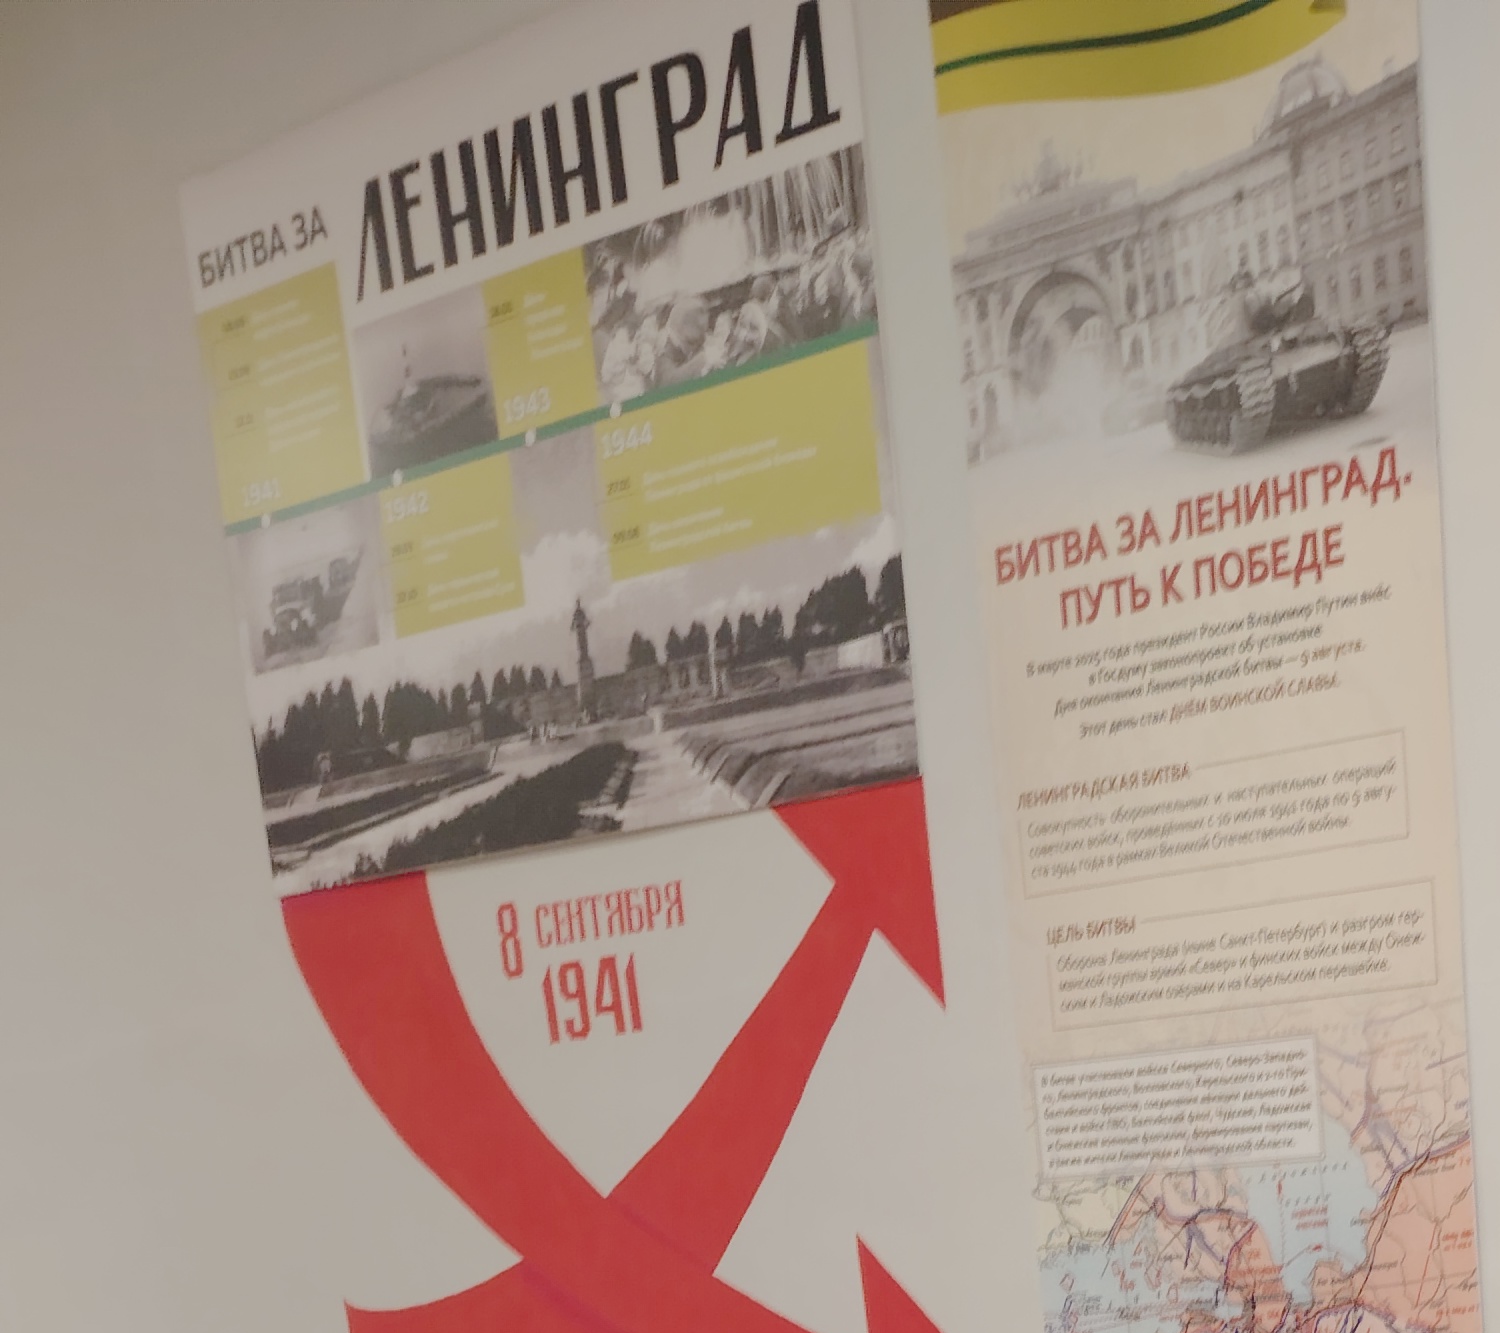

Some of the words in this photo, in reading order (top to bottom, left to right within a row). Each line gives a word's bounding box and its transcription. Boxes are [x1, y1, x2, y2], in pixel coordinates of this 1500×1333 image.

[199, 222, 286, 288] БИТВА
[295, 206, 330, 255] ЗА
[356, 0, 841, 303] ЛЕНИНГРАД
[995, 522, 1108, 586] БИТВА
[1116, 508, 1162, 555] ЗА
[1169, 445, 1414, 544] ЛЕНИНГРАД.
[1059, 568, 1151, 631] ПУТЬ
[1161, 563, 1185, 606] К
[1193, 522, 1346, 597] ПОБЕДЕ
[1016, 771, 1139, 809] ЛЕНИНГРАДСКАЯ
[496, 901, 524, 981] 8
[535, 879, 686, 949] СЕНТЯБРЯ
[542, 952, 643, 1045] 1941
